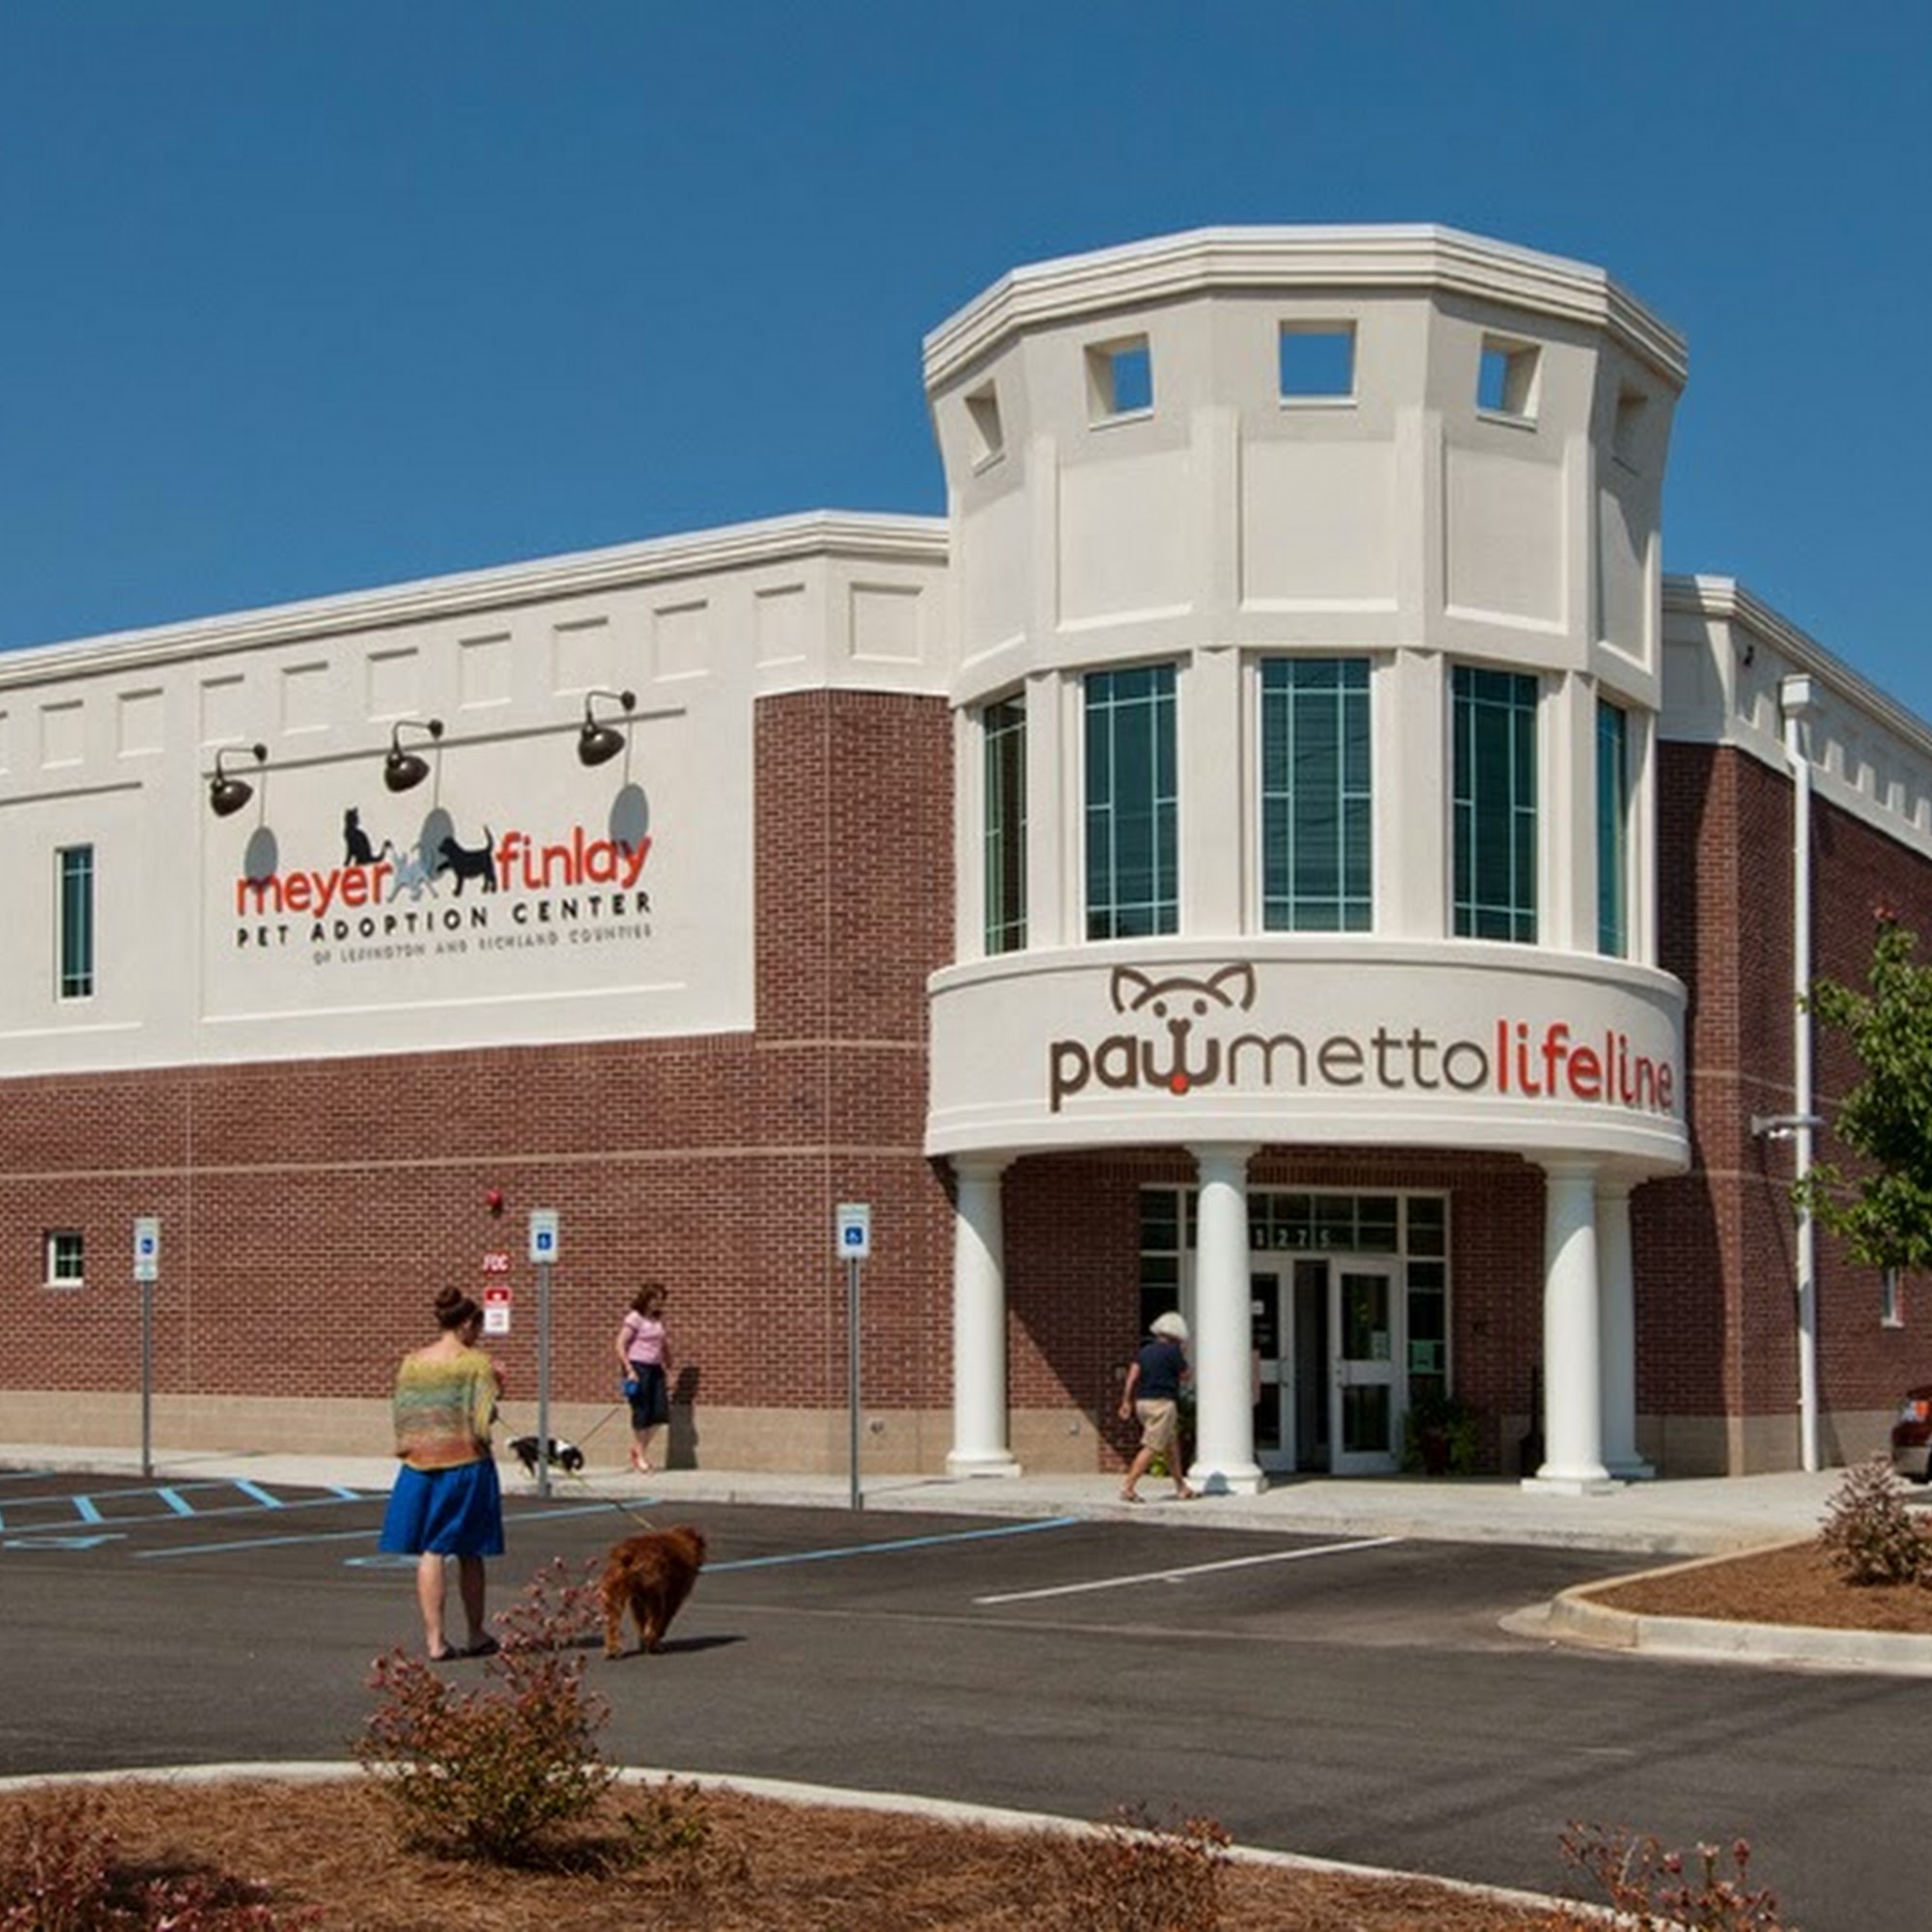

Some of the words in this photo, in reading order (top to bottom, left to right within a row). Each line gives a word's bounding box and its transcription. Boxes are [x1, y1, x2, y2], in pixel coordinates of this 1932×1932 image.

[238, 862, 393, 918] meyer
[496, 826, 652, 890] finlay
[237, 924, 288, 948] PET
[310, 907, 487, 943] ADOPTION
[512, 892, 651, 923] CENTER
